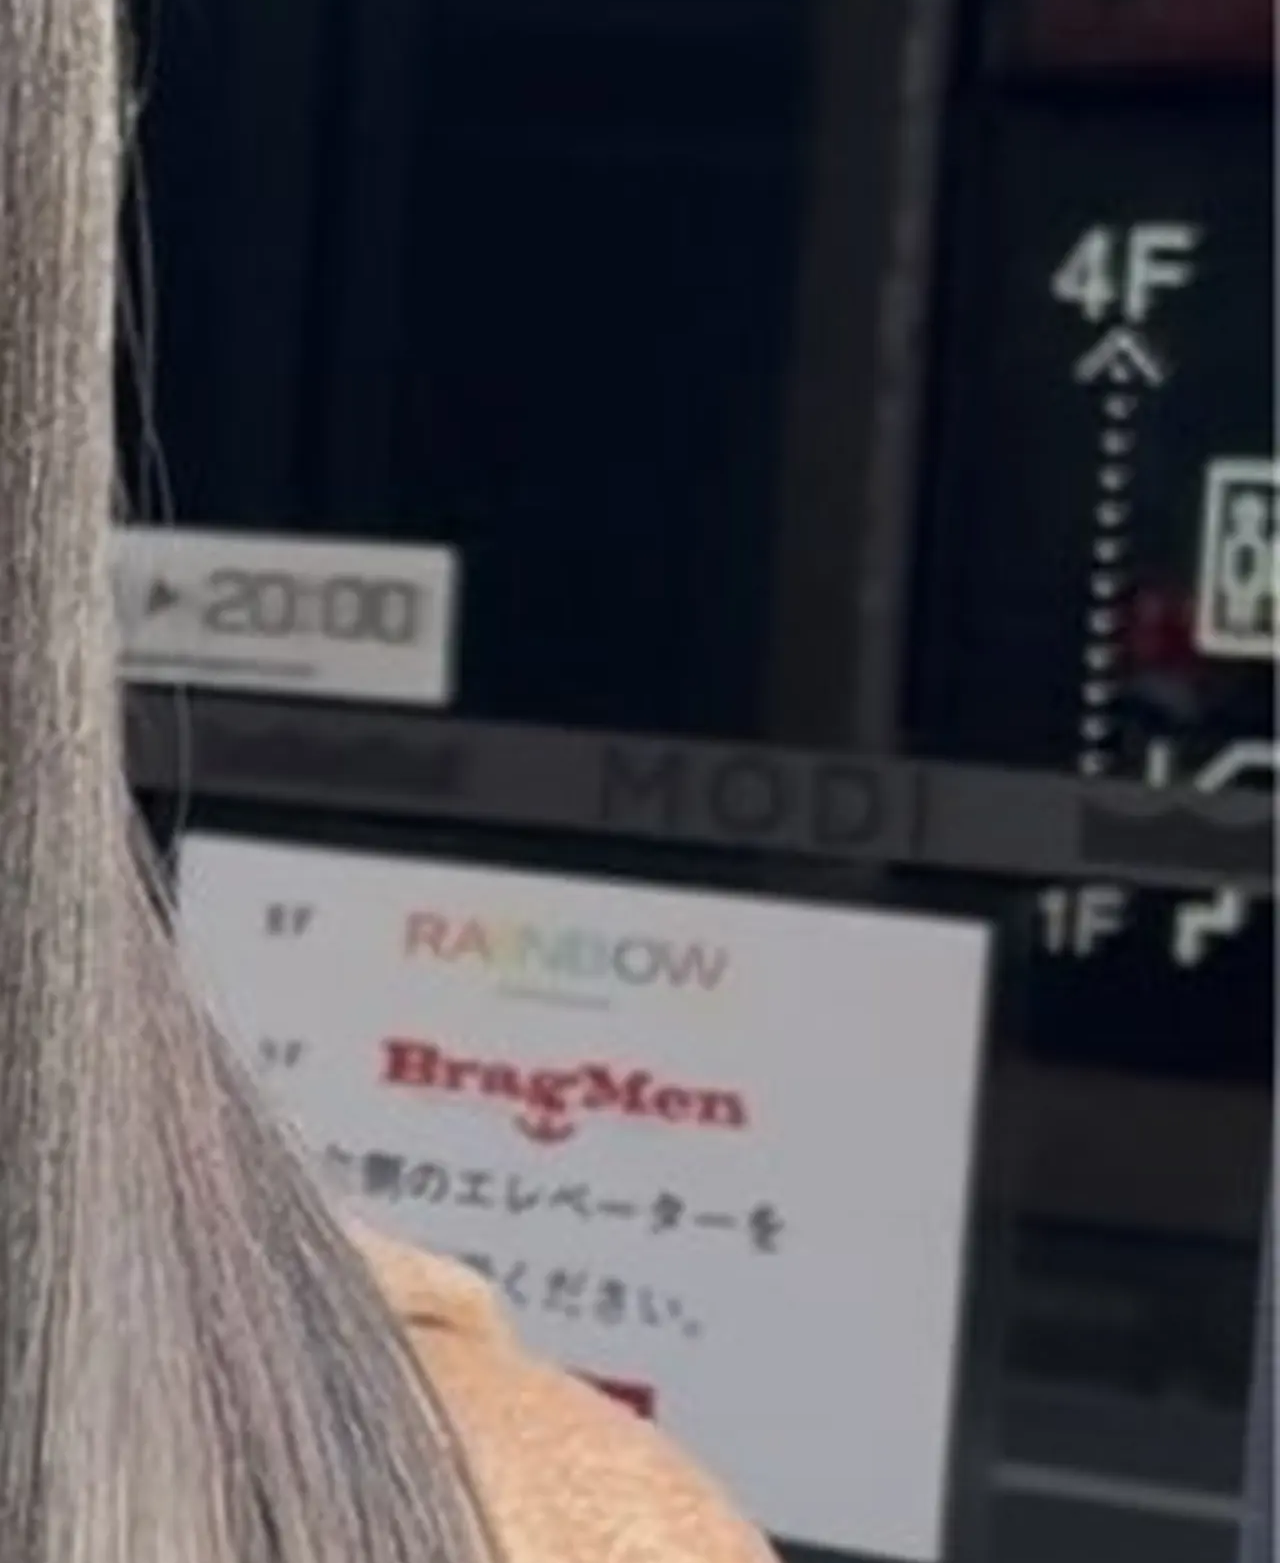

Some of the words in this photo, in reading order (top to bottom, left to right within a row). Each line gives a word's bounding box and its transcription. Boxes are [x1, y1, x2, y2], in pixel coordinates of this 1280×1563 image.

[1050, 224, 1196, 322] 4F
[600, 742, 928, 859] MODI
[403, 911, 729, 991] RAINBOW
[1042, 886, 1126, 957] 1F
[384, 1039, 748, 1129] BragMen
